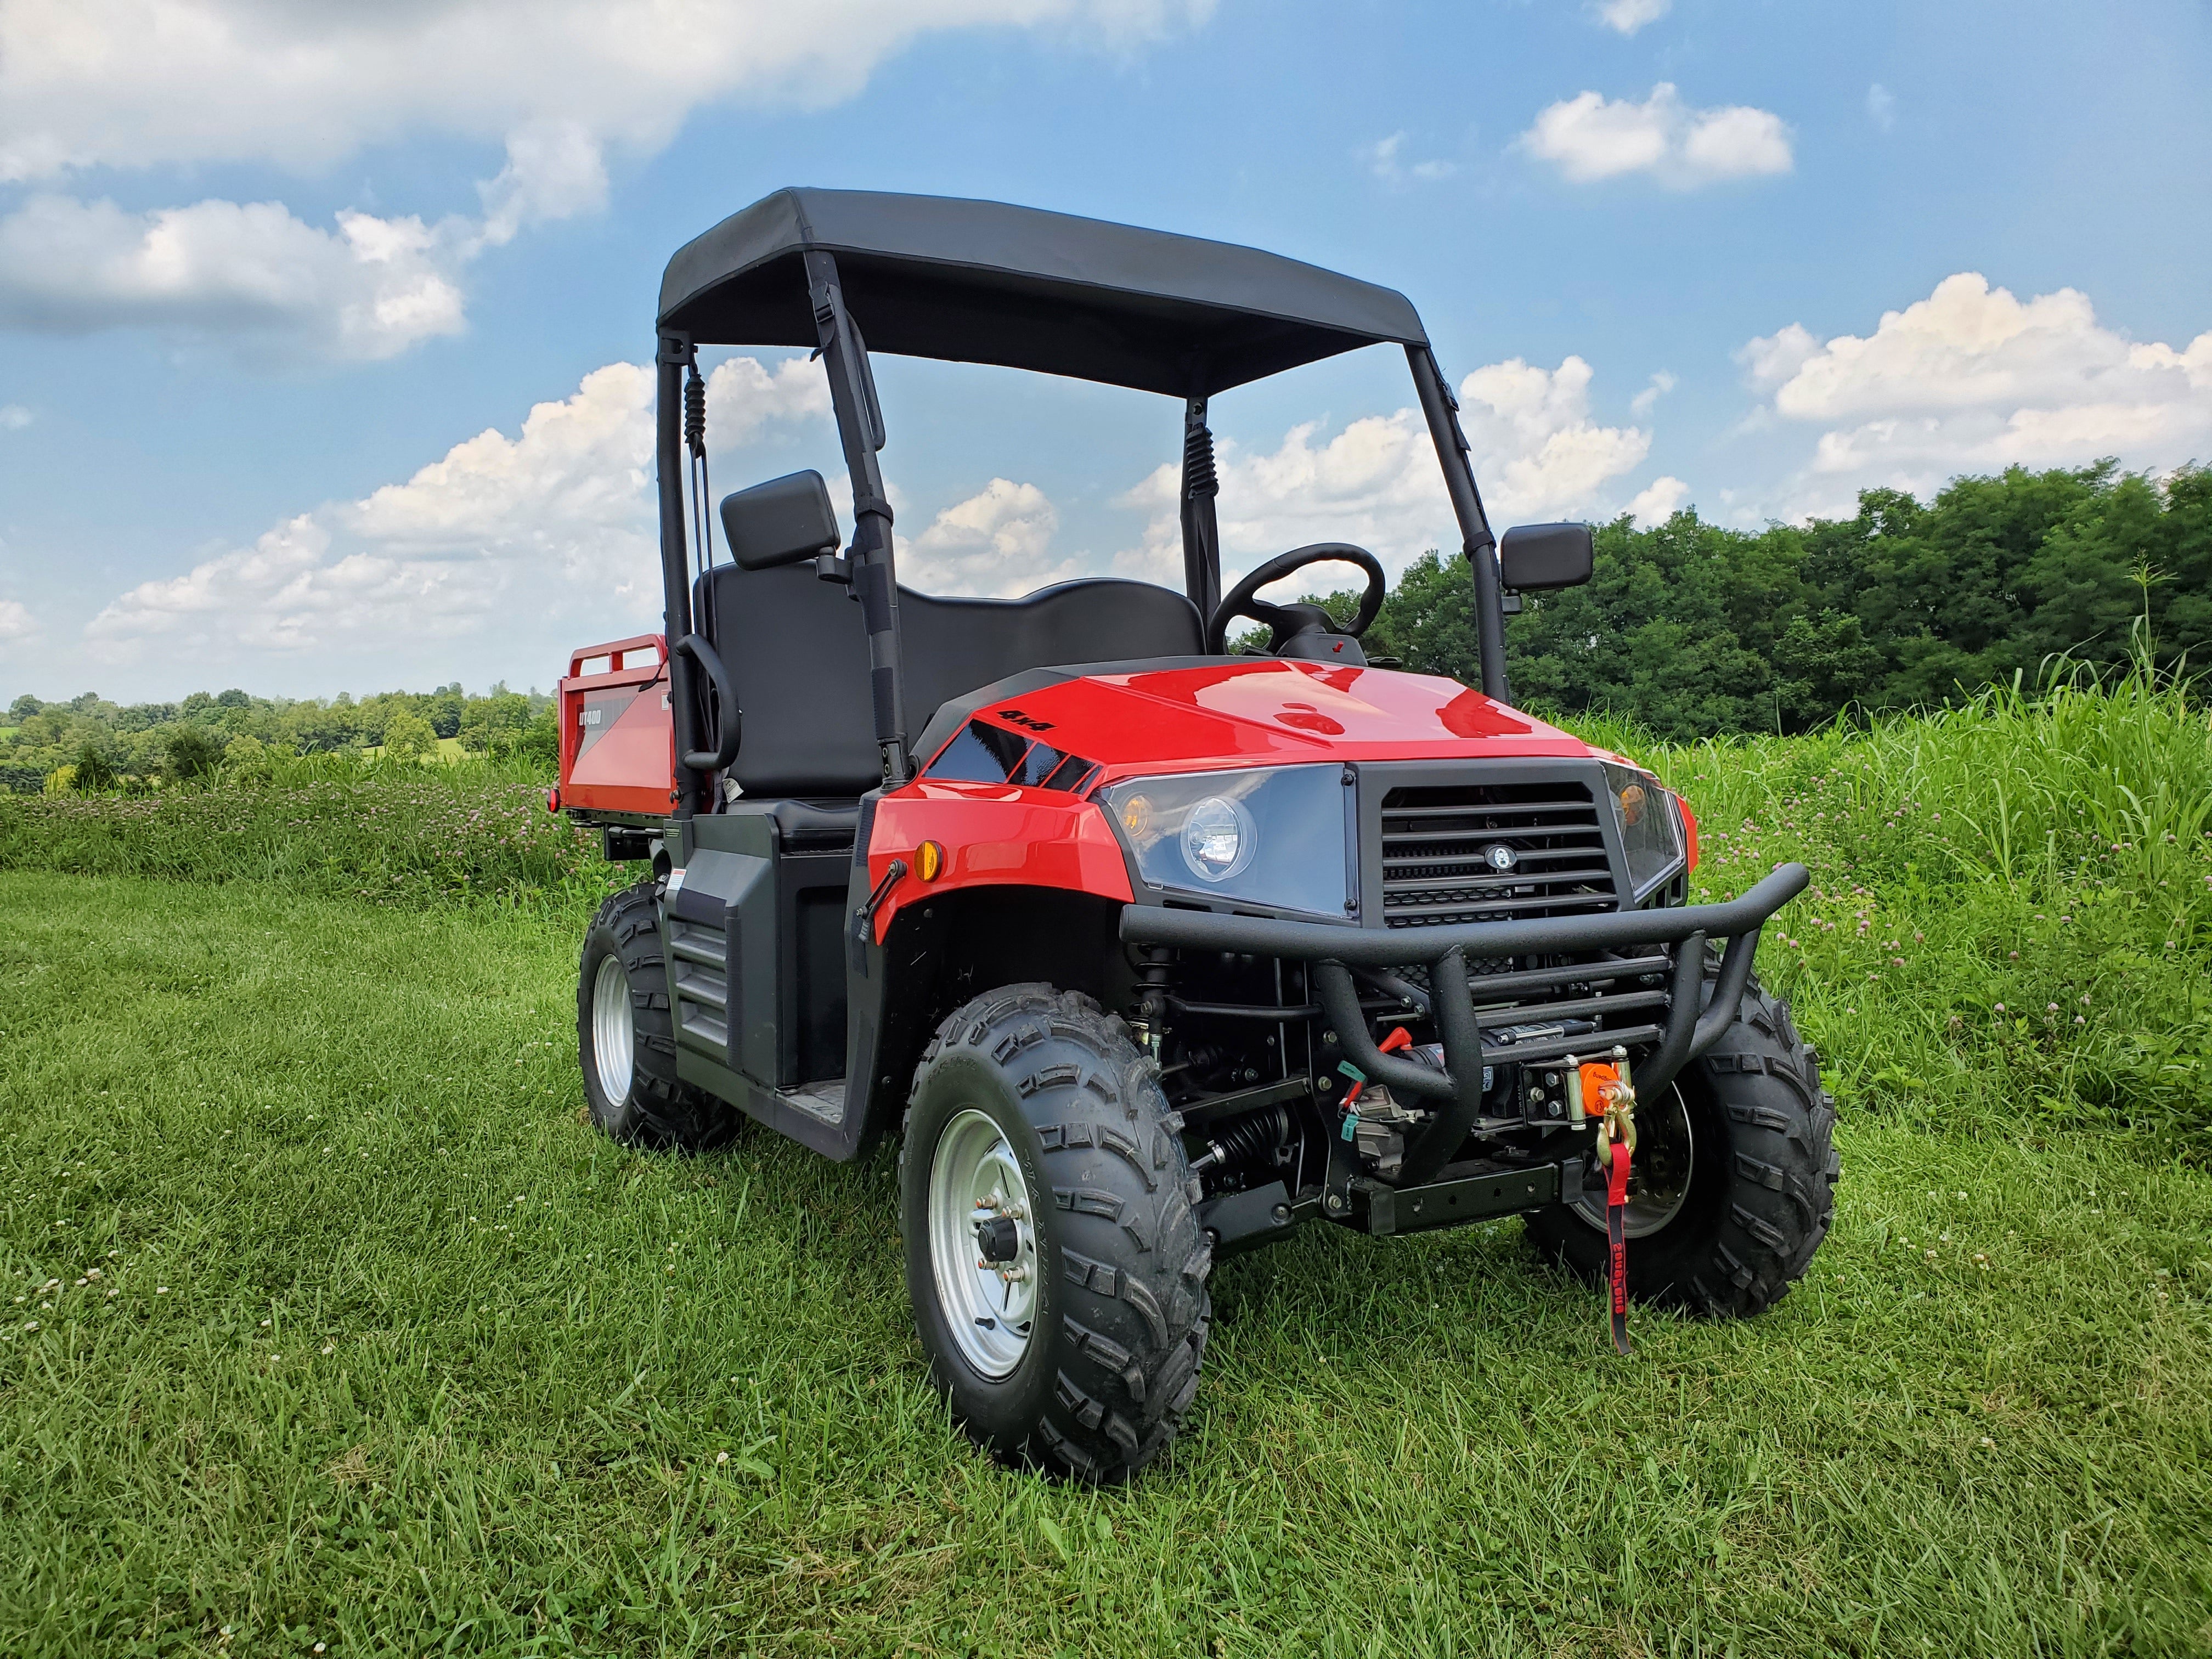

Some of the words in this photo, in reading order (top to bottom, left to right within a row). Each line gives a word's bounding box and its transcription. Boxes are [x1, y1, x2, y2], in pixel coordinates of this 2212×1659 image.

[579, 709, 601, 726] UT400
[996, 710, 1058, 731] 4x4
[1023, 1148, 1049, 1315] WANDA
